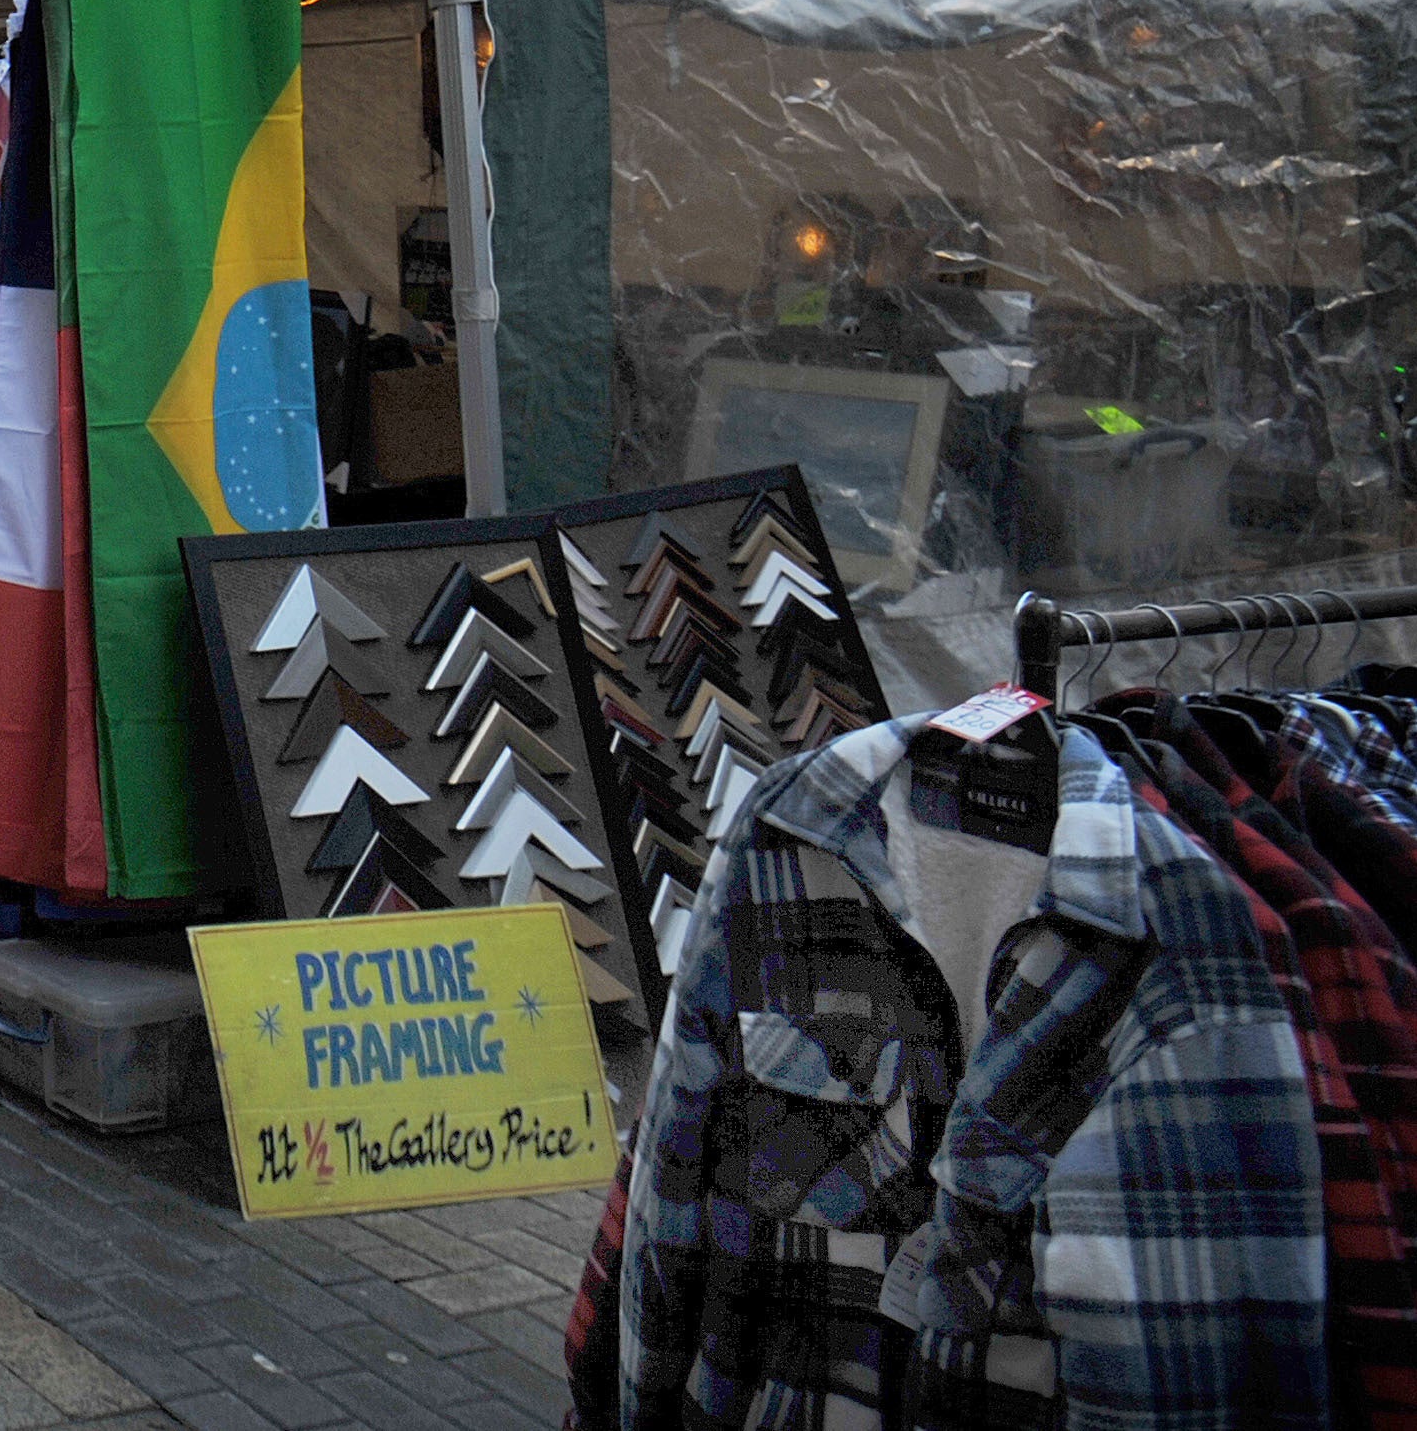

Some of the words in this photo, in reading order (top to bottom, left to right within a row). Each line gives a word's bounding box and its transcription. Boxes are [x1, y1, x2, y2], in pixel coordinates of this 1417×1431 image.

[295, 939, 487, 1013] PICTURE
[302, 1011, 506, 1090] FRAMING
[257, 1122, 299, 1185] At
